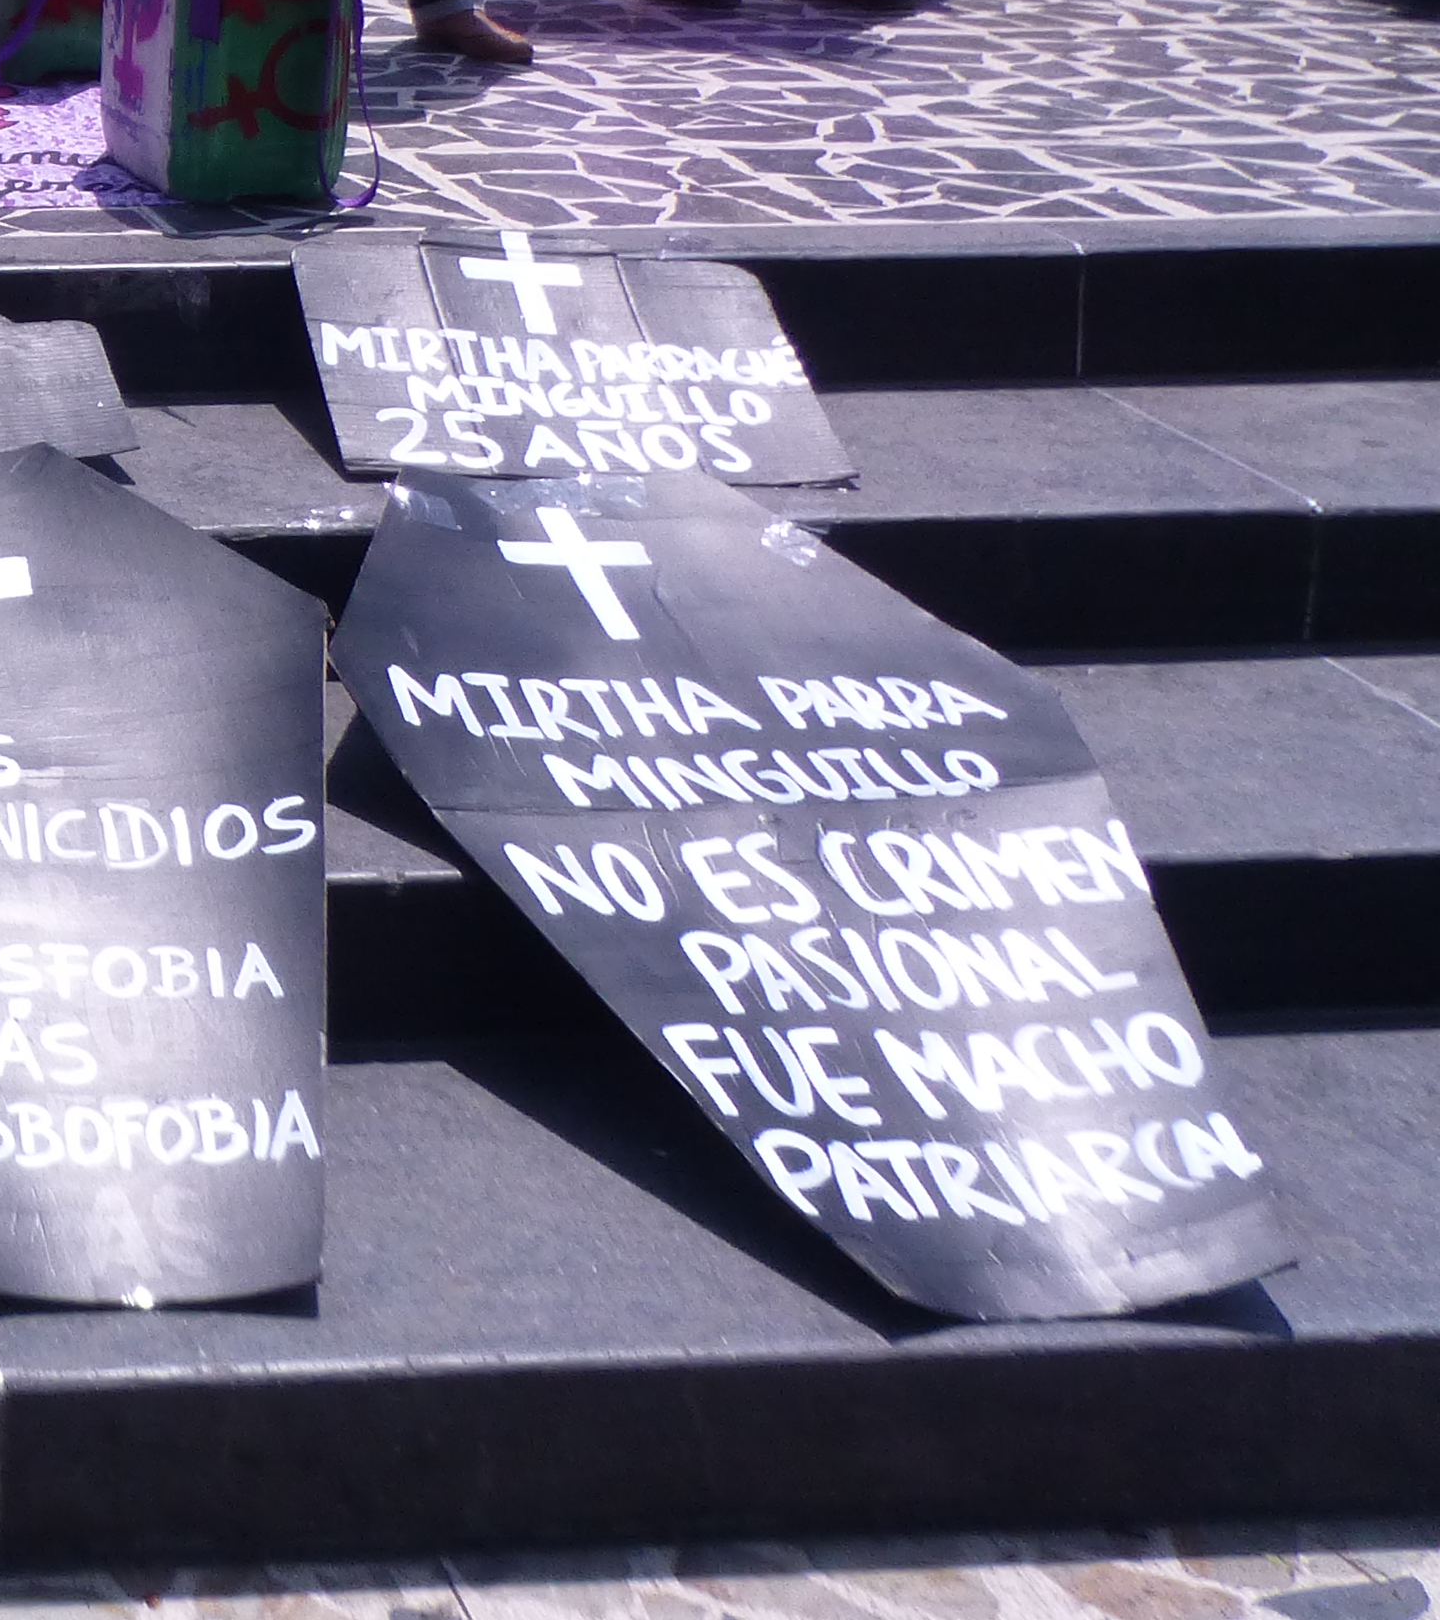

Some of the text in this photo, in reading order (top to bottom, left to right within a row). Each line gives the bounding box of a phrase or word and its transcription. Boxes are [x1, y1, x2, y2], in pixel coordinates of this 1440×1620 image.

[319, 322, 572, 382] MIRTHA
[375, 406, 753, 473] 25 AÑOS
[406, 375, 773, 426] MINGUILLO
[388, 664, 1008, 742] MIRTHA PARRA
[542, 748, 1000, 812] MINGUILLO
[502, 819, 1150, 925] NO ES CRIMEN
[681, 926, 1138, 1015] PASIONAL
[662, 1011, 1205, 1126] FUE MACHO
[752, 1110, 1263, 1224] PATRIARCAL
